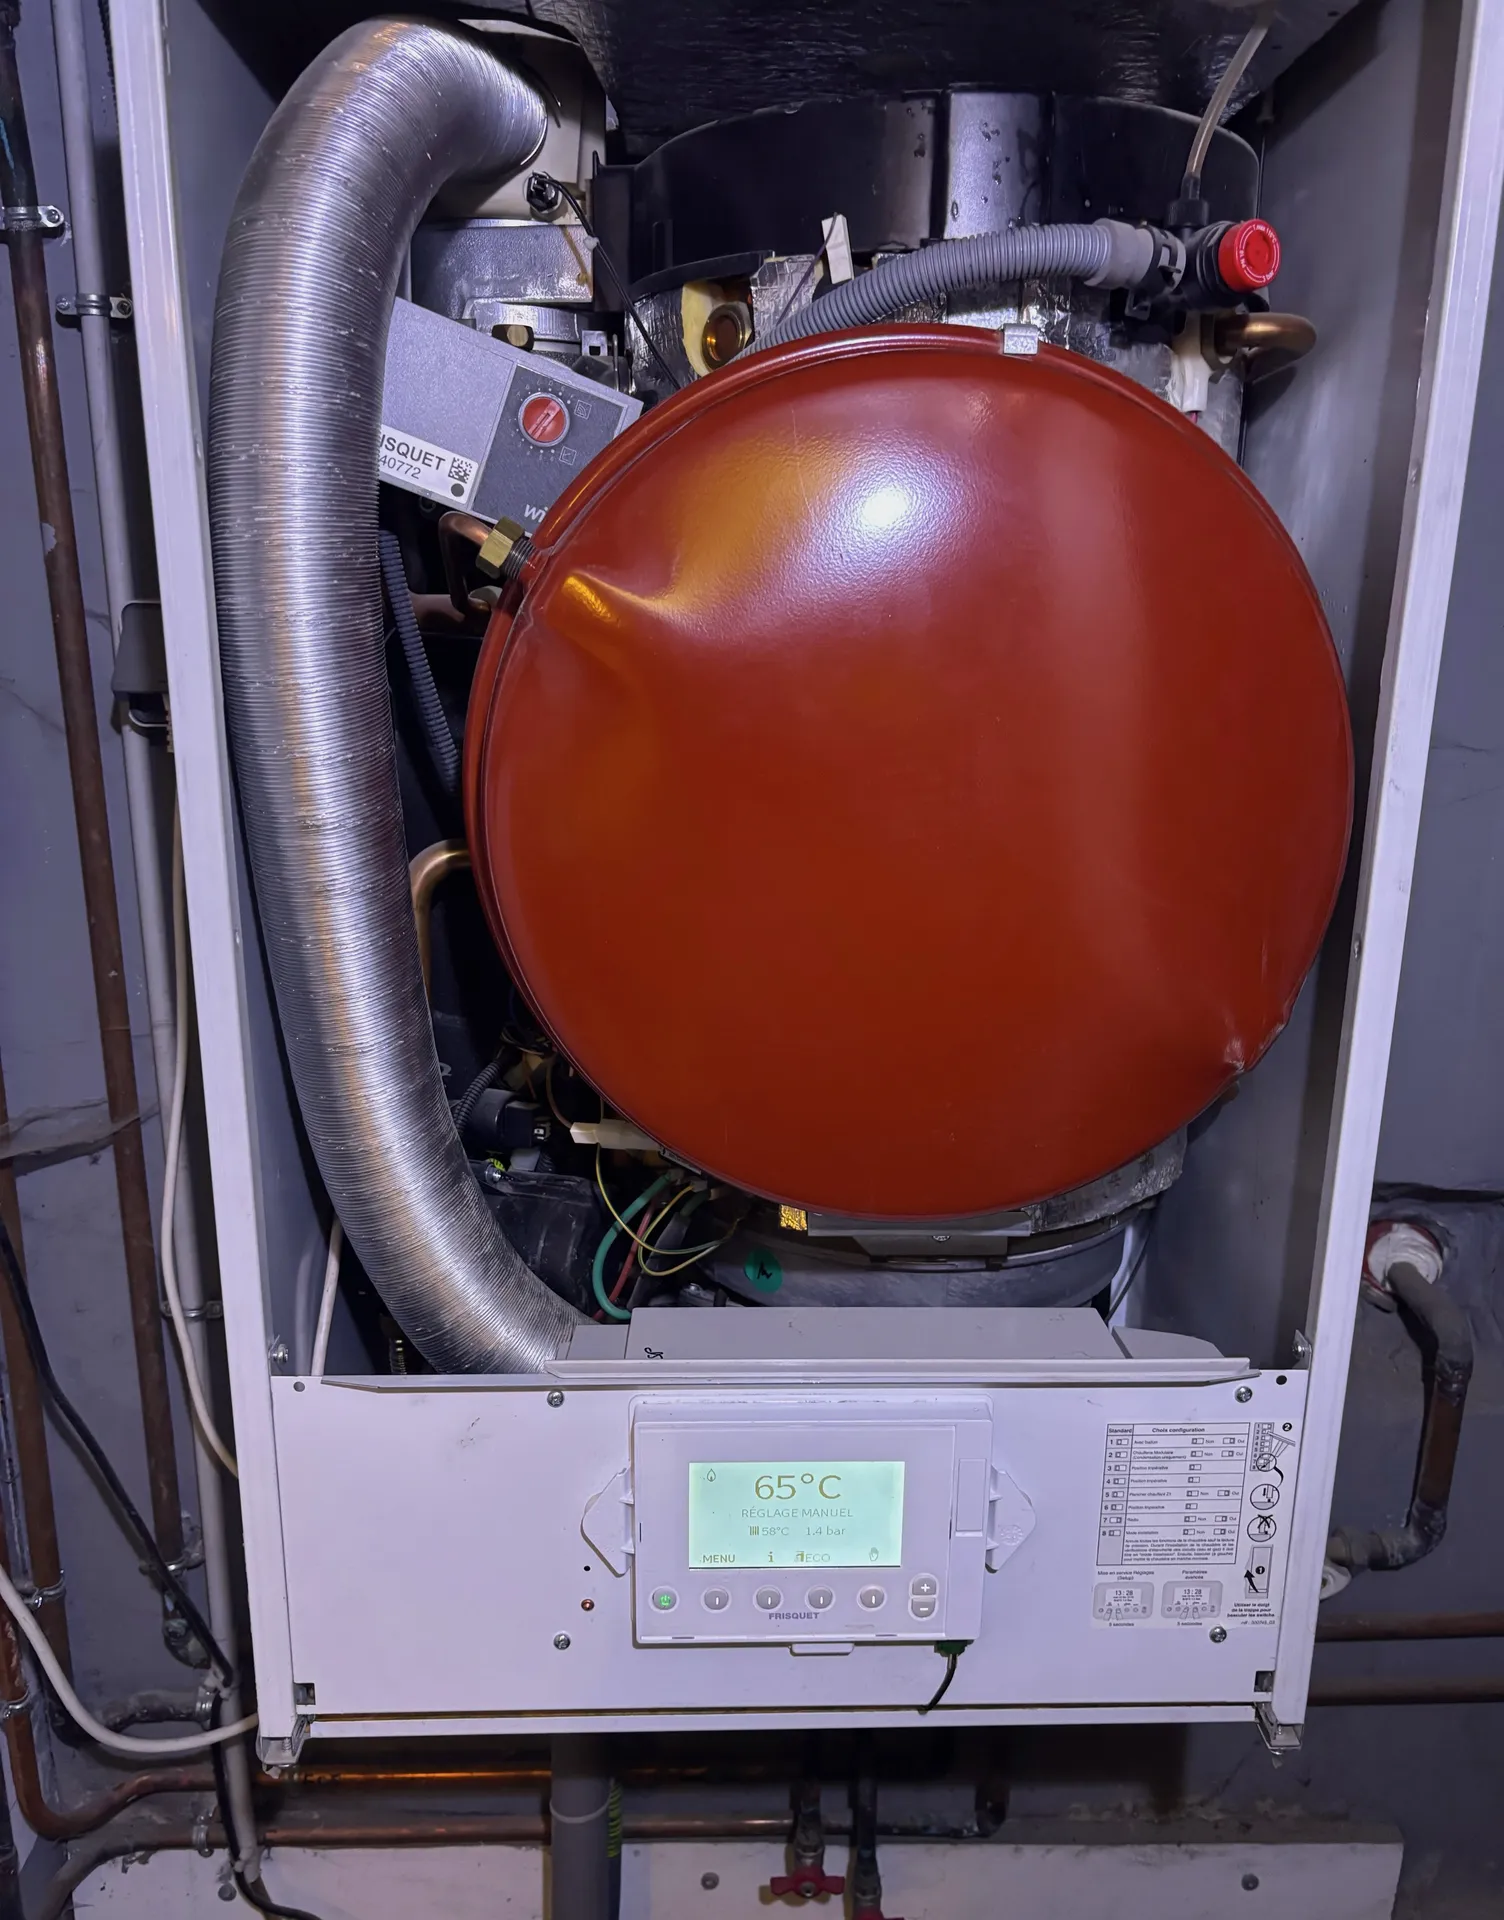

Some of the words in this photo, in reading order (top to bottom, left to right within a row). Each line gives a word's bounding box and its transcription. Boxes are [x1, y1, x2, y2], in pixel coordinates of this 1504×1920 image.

[380, 434, 446, 471] ISQUET
[379, 455, 421, 480] 40772
[754, 1473, 842, 1500] 65°C
[741, 1506, 798, 1518] RÉGLAGE
[801, 1508, 853, 1518] MANUEL
[762, 1526, 790, 1536] 58°C
[806, 1526, 822, 1536] 1.4
[827, 1525, 845, 1536] bar
[702, 1554, 736, 1563] MENU
[805, 1553, 831, 1562] ECO
[768, 1612, 820, 1621] FRISQUET
